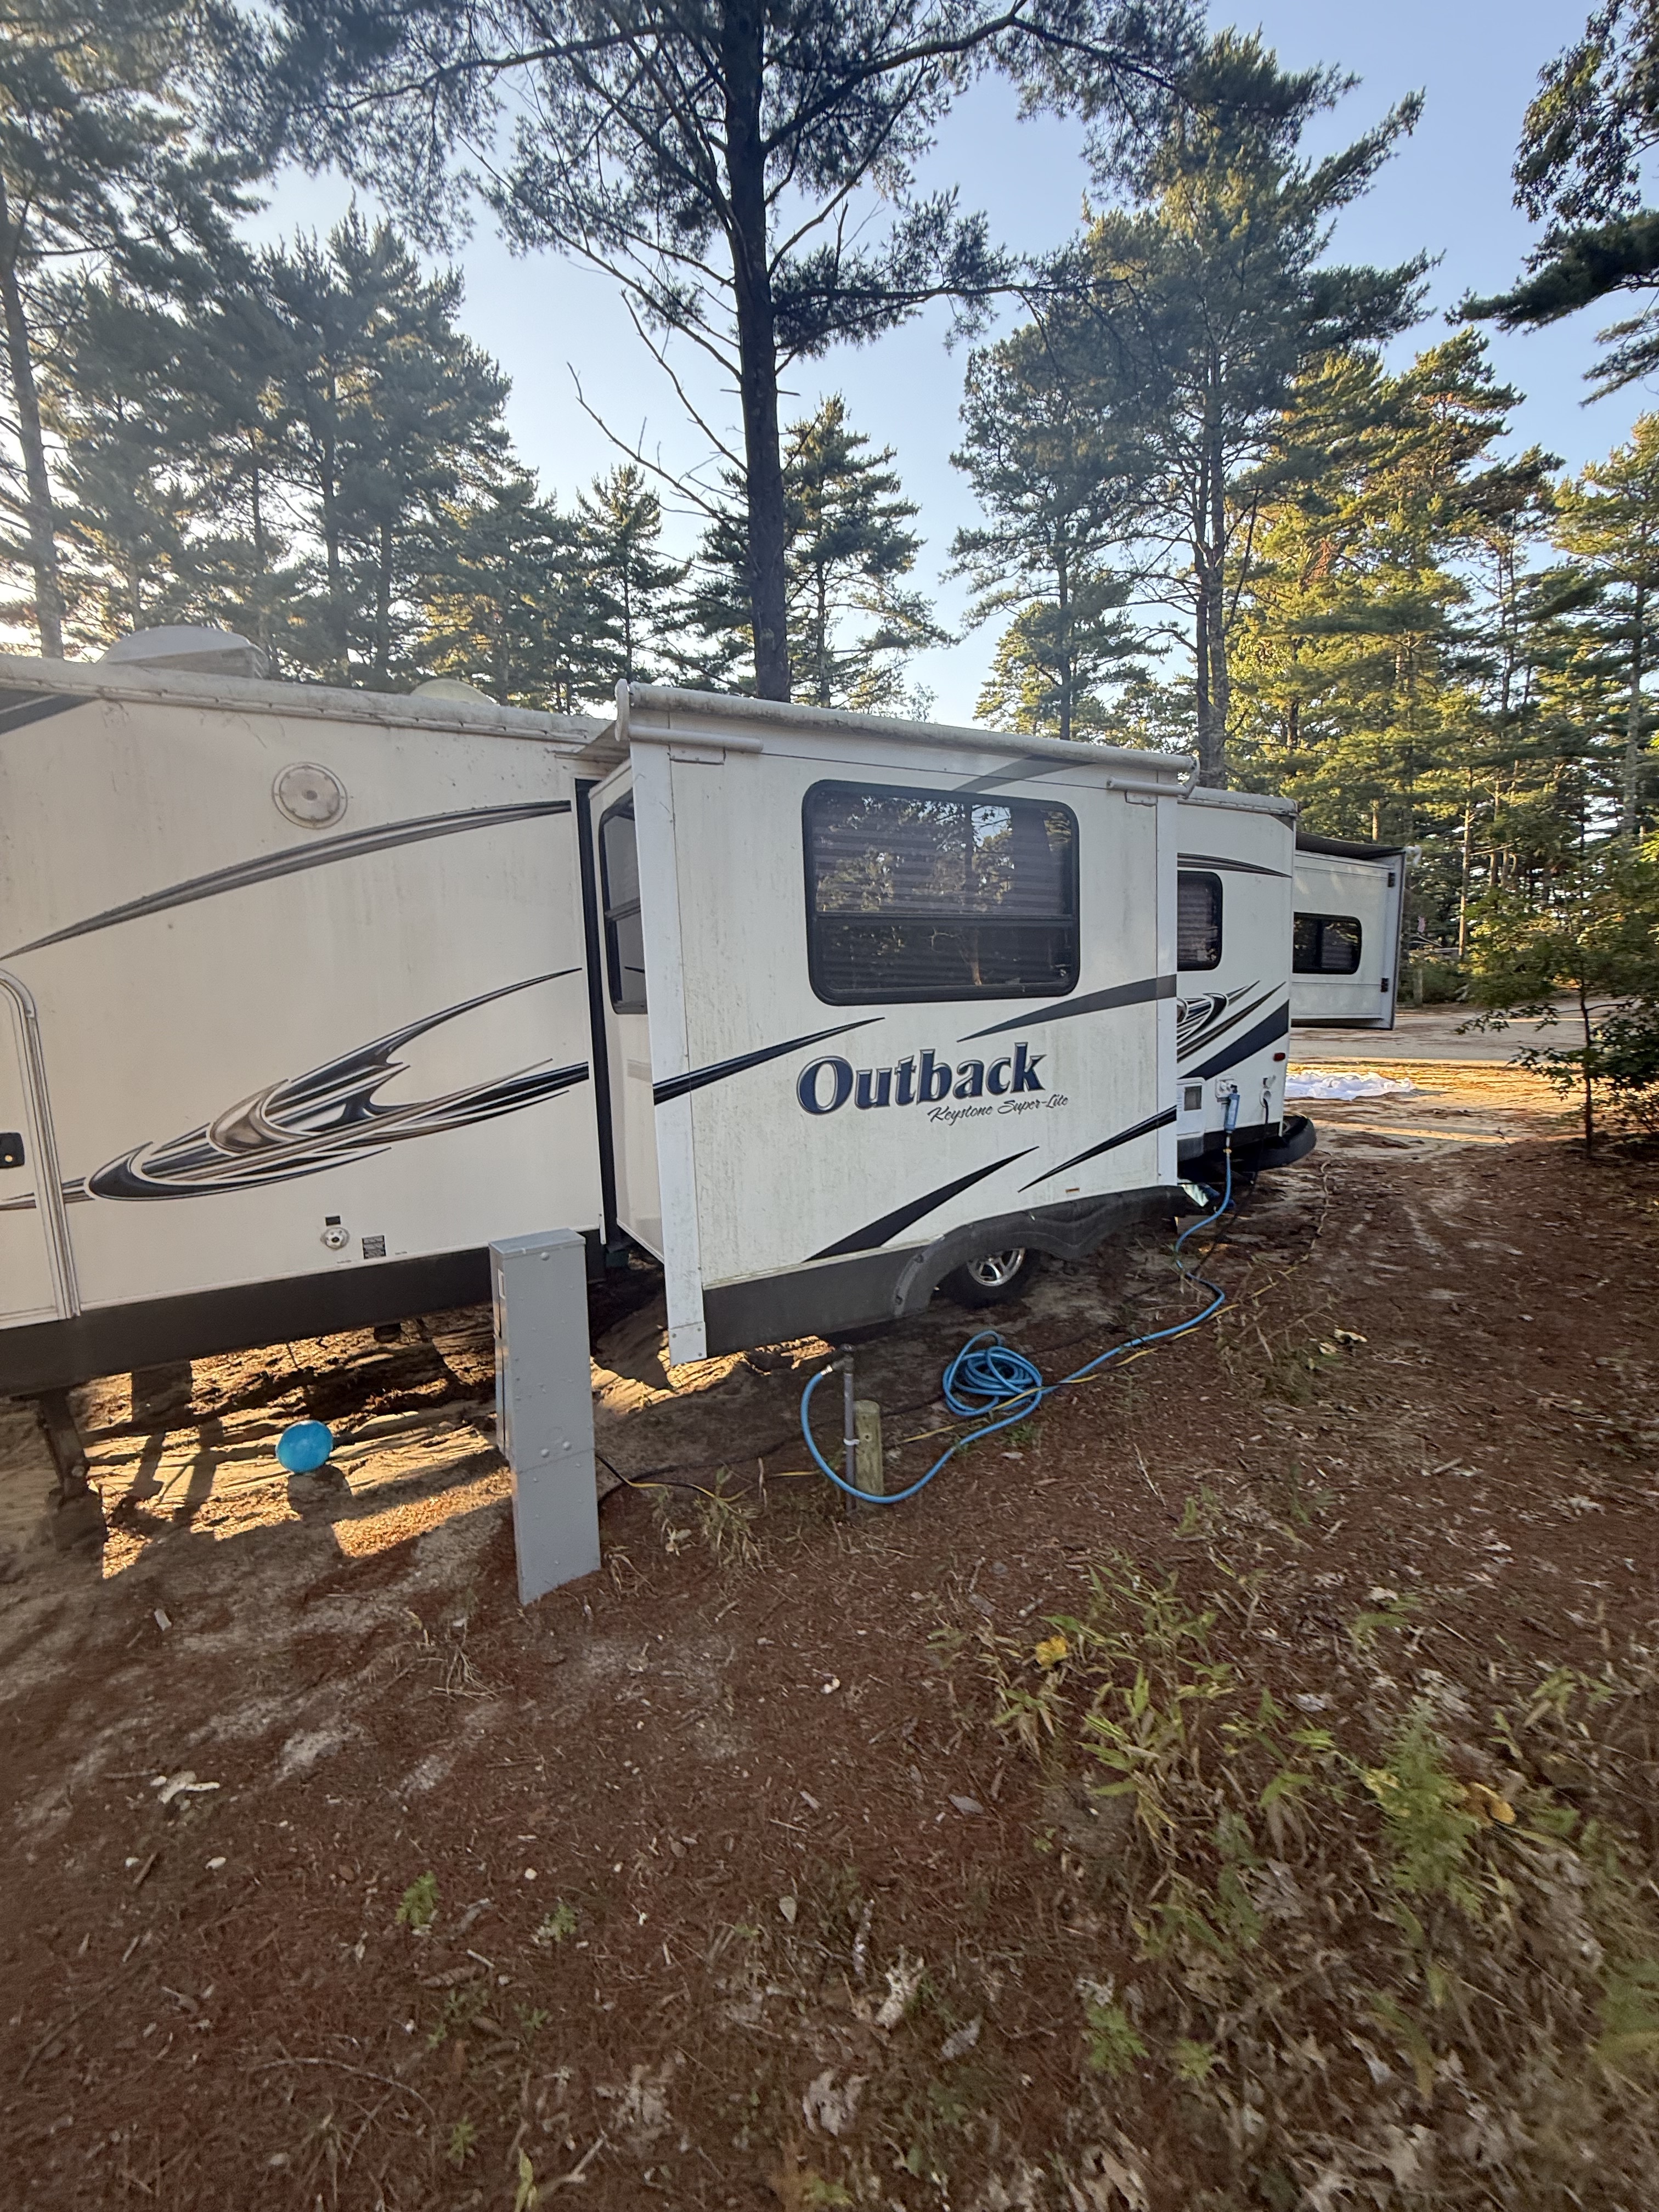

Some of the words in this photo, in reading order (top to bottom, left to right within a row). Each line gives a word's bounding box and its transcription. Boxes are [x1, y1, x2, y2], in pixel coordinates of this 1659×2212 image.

[796, 1041, 1047, 1116] Outback
[927, 1105, 994, 1126] Keystone
[997, 1093, 1069, 1115] Super-Lite
